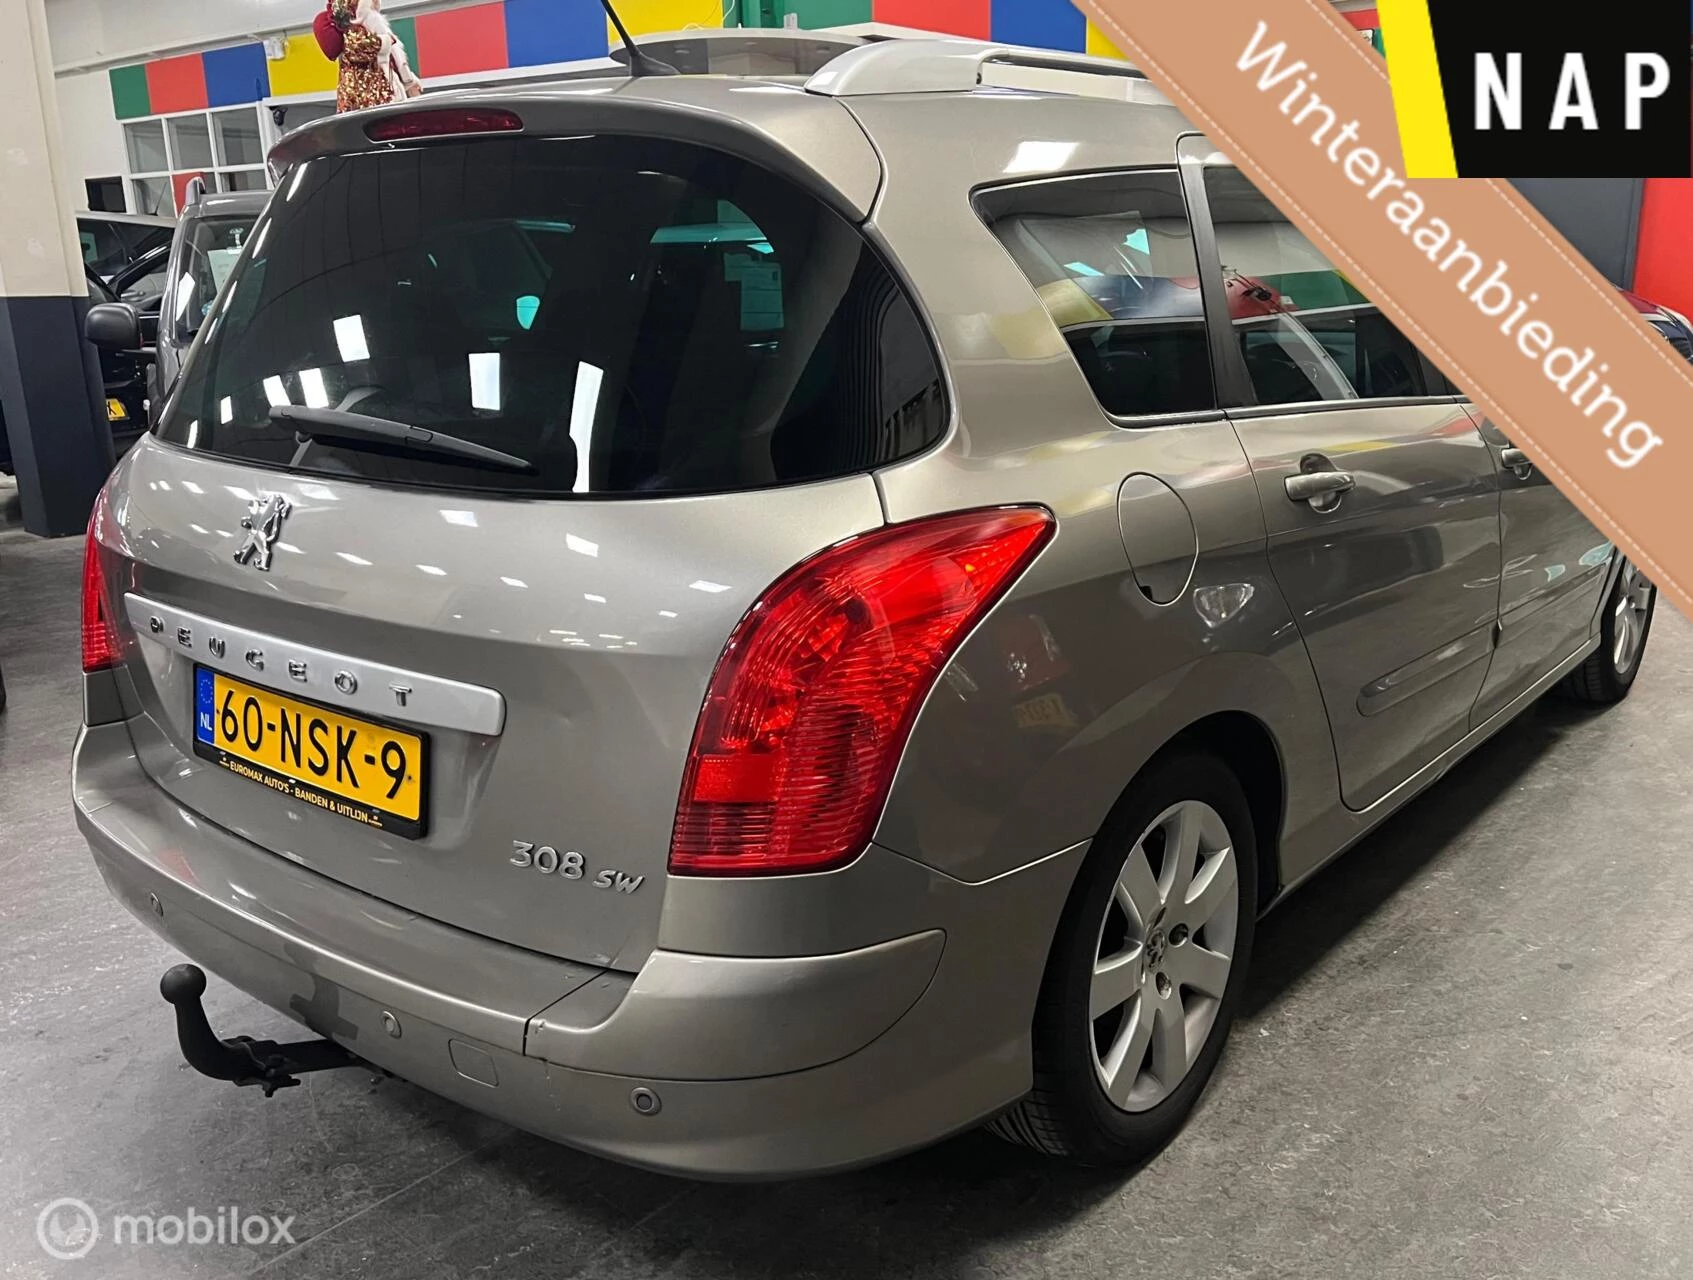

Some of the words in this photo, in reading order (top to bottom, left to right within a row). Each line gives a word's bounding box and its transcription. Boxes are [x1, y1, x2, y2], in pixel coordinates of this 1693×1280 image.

[149, 615, 413, 707] PEUGEOT
[200, 712, 213, 731] NL
[220, 689, 407, 800] 60-NSK-9
[229, 760, 263, 783] EUROMAX
[264, 775, 290, 794] AUTO'S
[294, 787, 329, 808] BANDEN
[329, 799, 336, 812] &
[336, 803, 369, 824] UITLIJN
[509, 839, 586, 881] 308
[592, 869, 645, 895] SW
